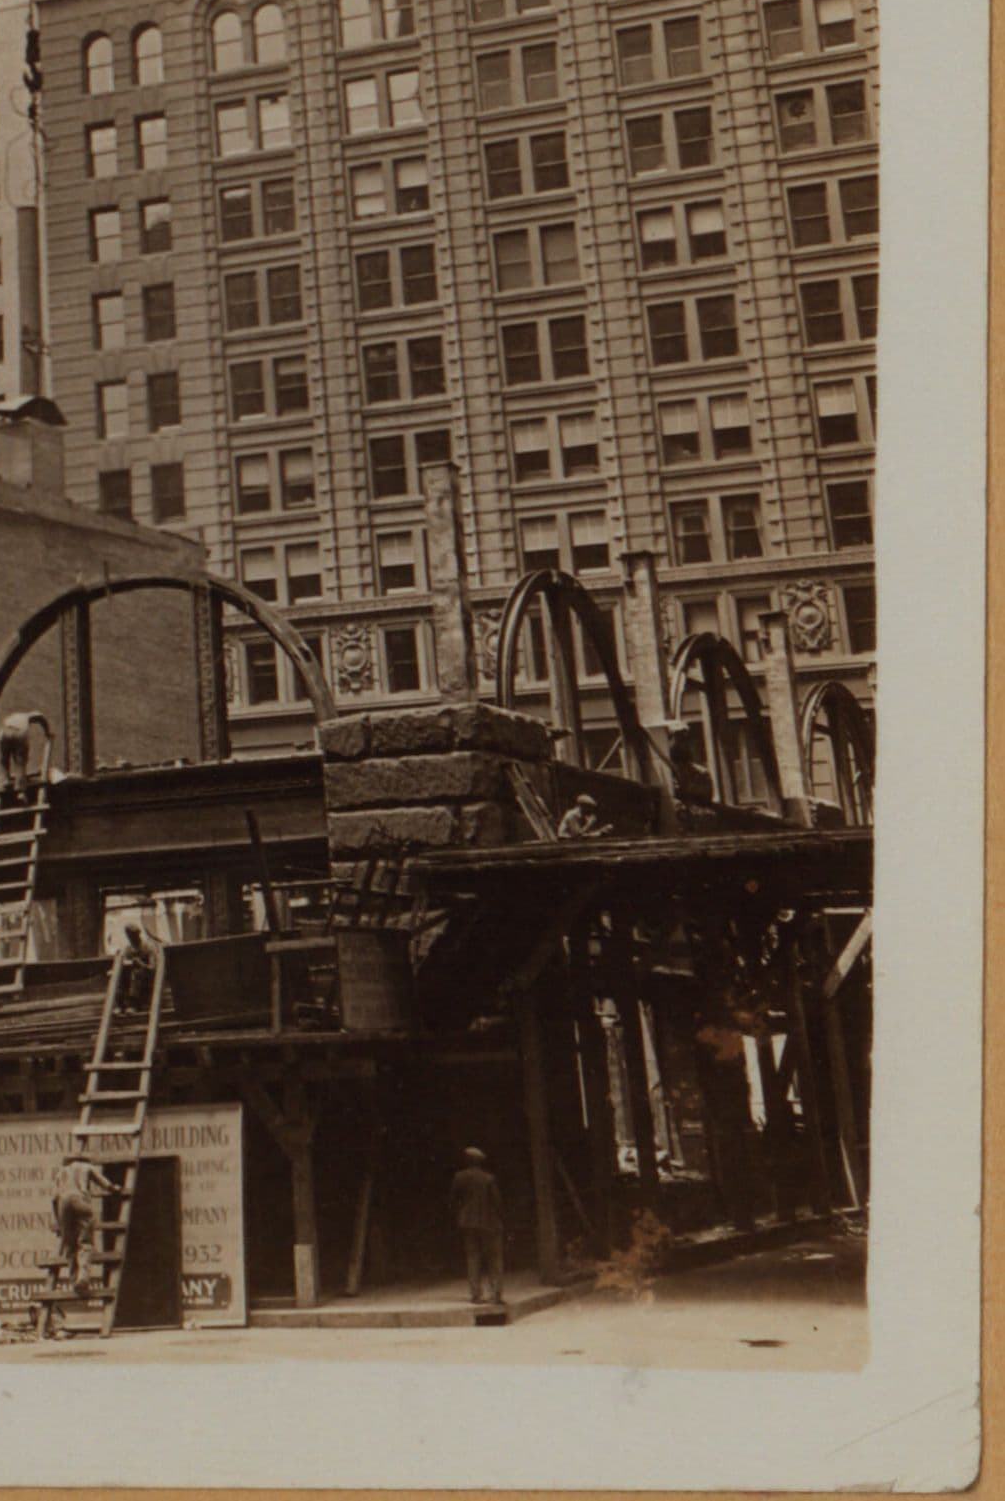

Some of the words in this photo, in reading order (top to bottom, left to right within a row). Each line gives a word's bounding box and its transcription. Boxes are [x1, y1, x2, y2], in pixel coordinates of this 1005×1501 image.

[152, 1125, 230, 1150] BUILDING
[183, 1207, 228, 1226] MPANY
[185, 1244, 222, 1263] 932
